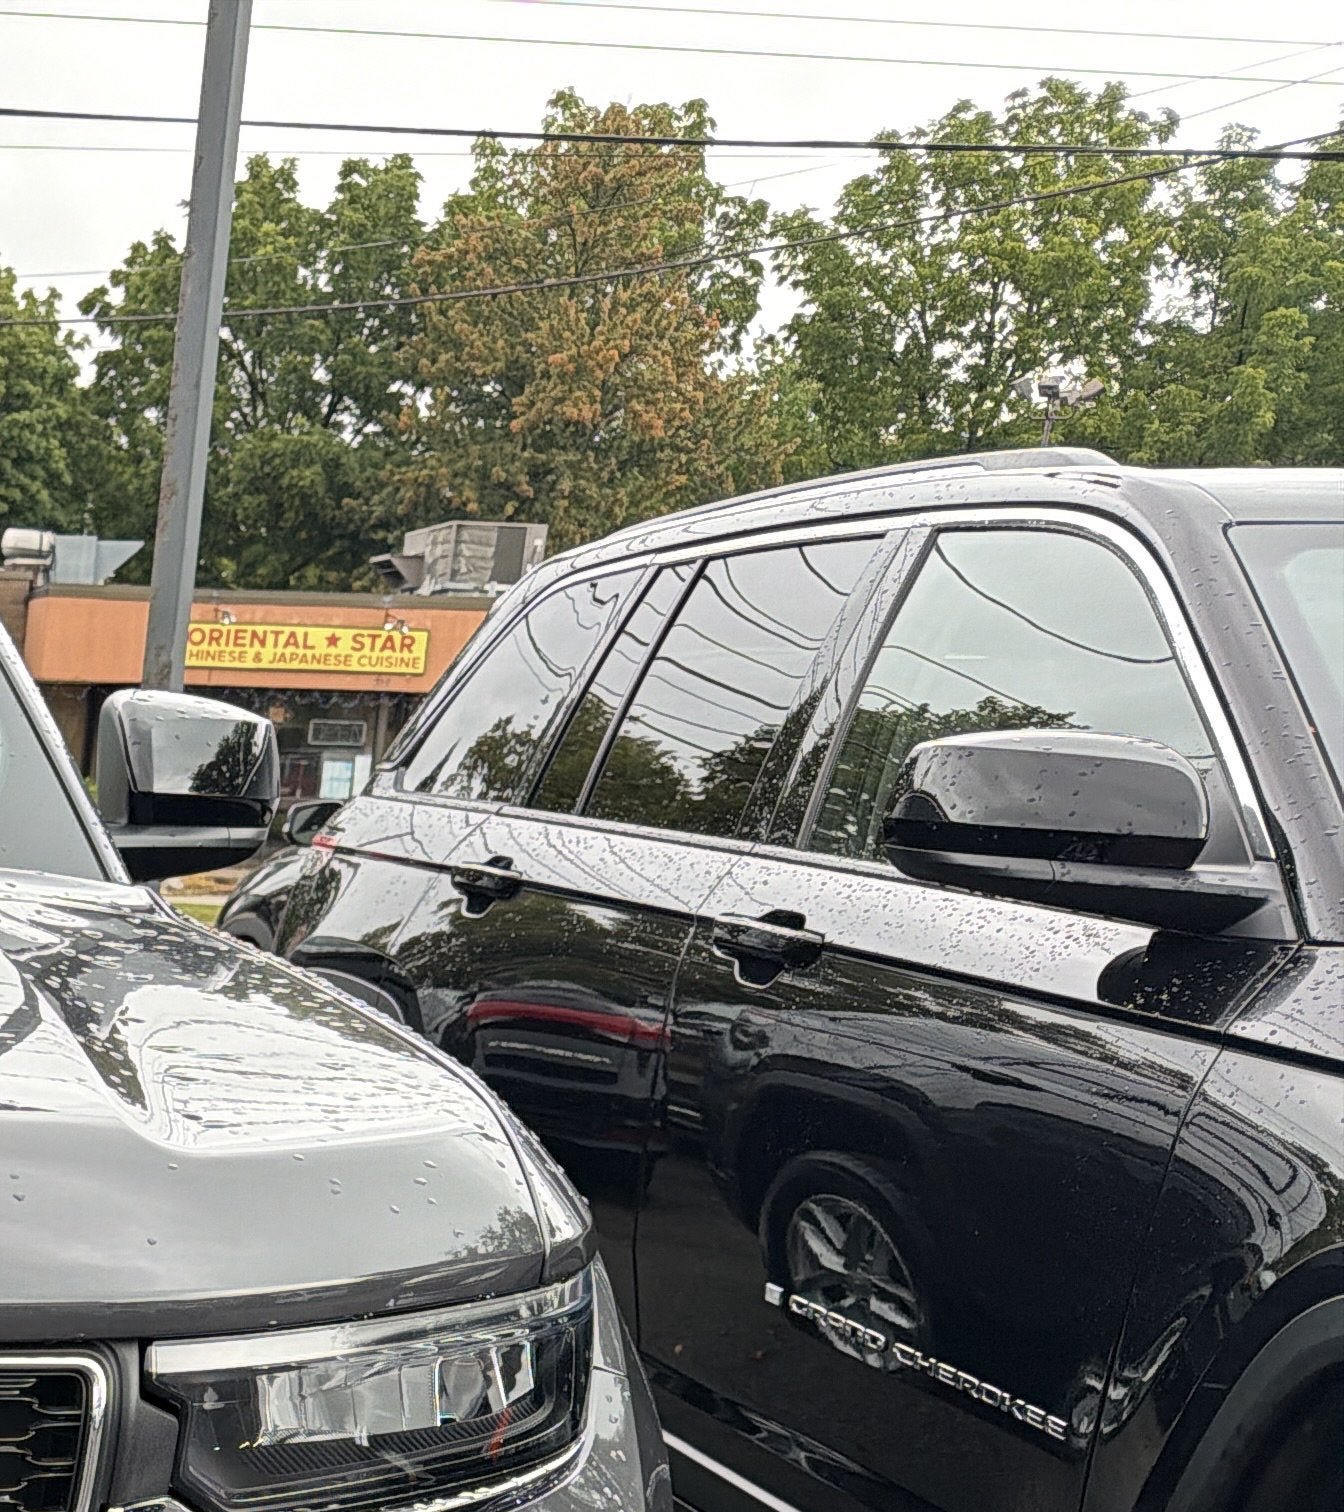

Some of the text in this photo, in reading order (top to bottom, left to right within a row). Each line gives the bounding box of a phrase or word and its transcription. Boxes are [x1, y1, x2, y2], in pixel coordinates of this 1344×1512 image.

[188, 627, 416, 654] ORIENTAL STAR
[188, 649, 421, 669] HINESE & JAPANESE CUISINE
[789, 1294, 1068, 1440] GRAND CHEROKEE
